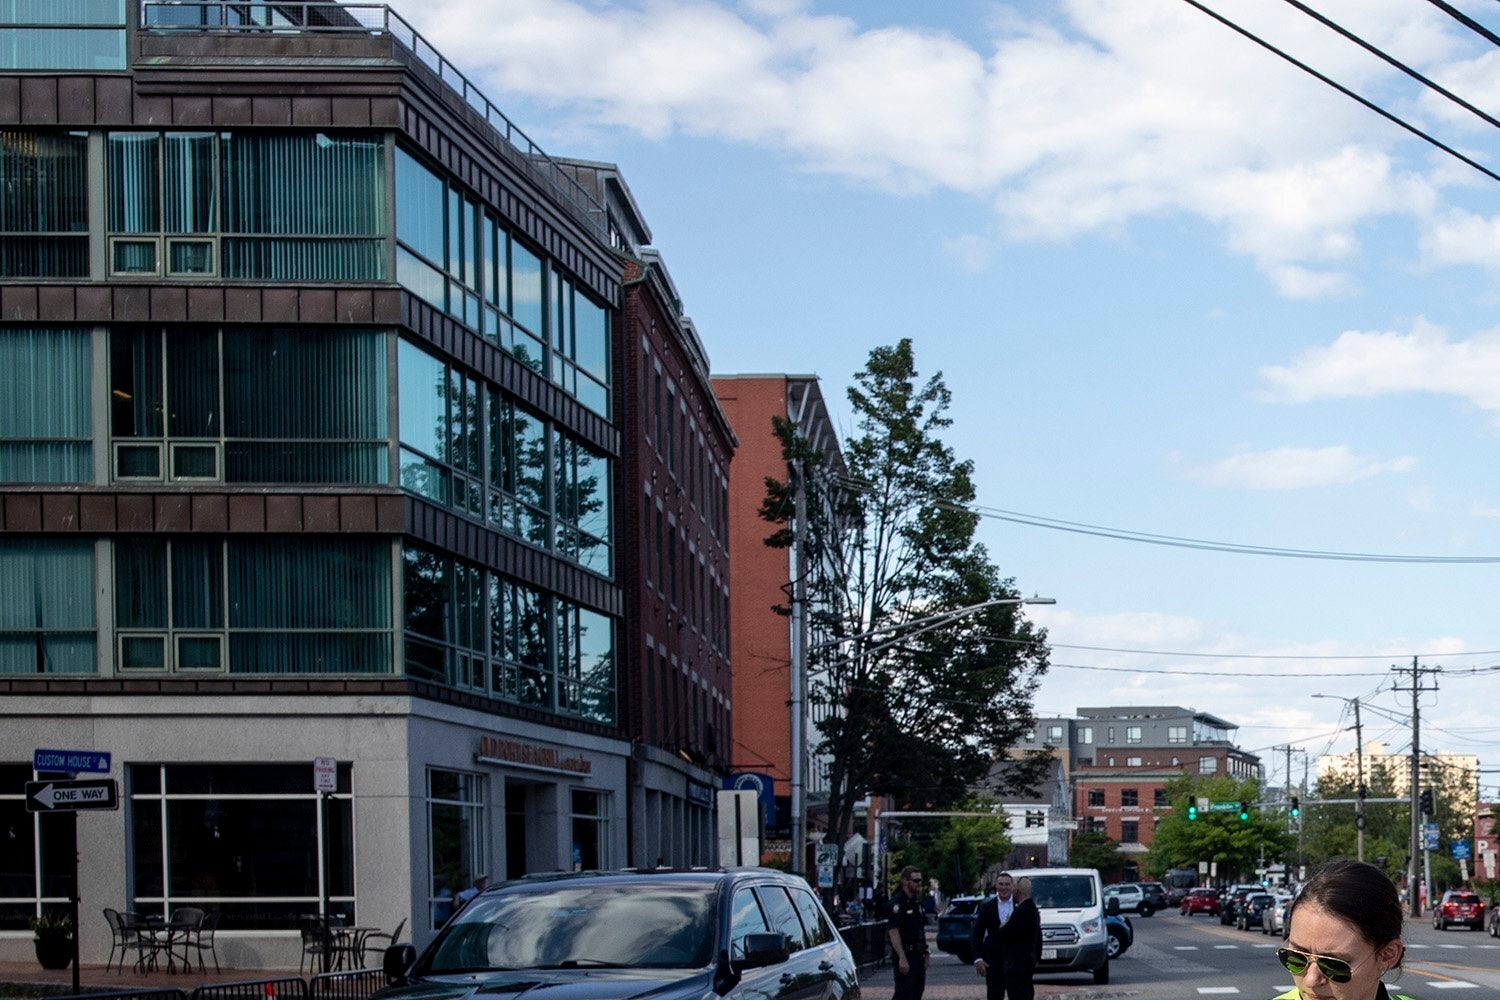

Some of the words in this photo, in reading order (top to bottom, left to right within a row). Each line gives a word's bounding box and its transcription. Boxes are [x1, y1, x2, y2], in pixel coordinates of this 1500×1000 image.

[37, 754, 65, 767] CUSTOM
[67, 755, 91, 768] HOUSE
[53, 790, 77, 801] ONE
[81, 788, 104, 799] WAY
[1477, 840, 1489, 854] P
